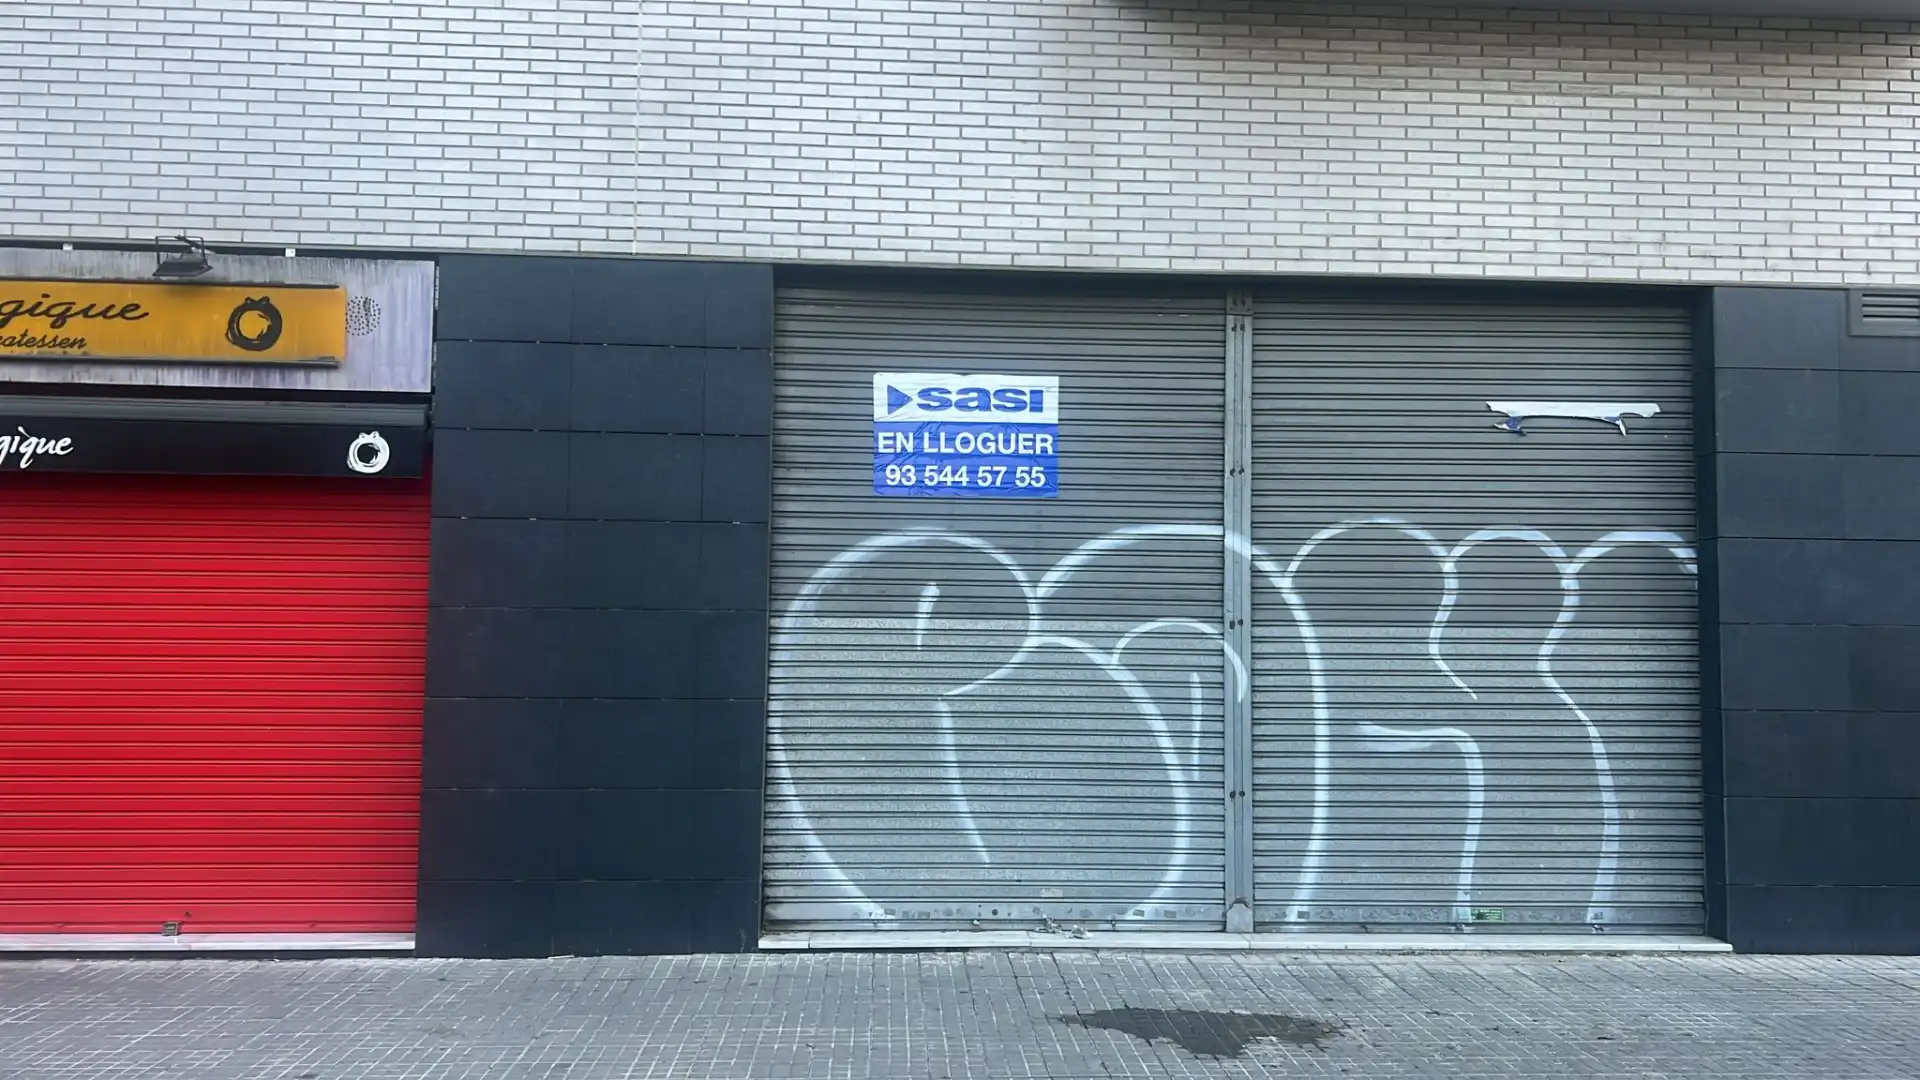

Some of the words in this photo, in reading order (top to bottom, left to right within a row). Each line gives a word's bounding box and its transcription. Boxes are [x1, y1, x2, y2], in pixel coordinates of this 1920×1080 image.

[0, 329, 87, 349] atessen
[878, 432, 914, 454] EN
[923, 432, 1053, 455] LLOGUER
[885, 465, 916, 487] 93
[924, 465, 969, 487] 544
[977, 466, 1007, 487] 57
[1015, 466, 1046, 488] 55
